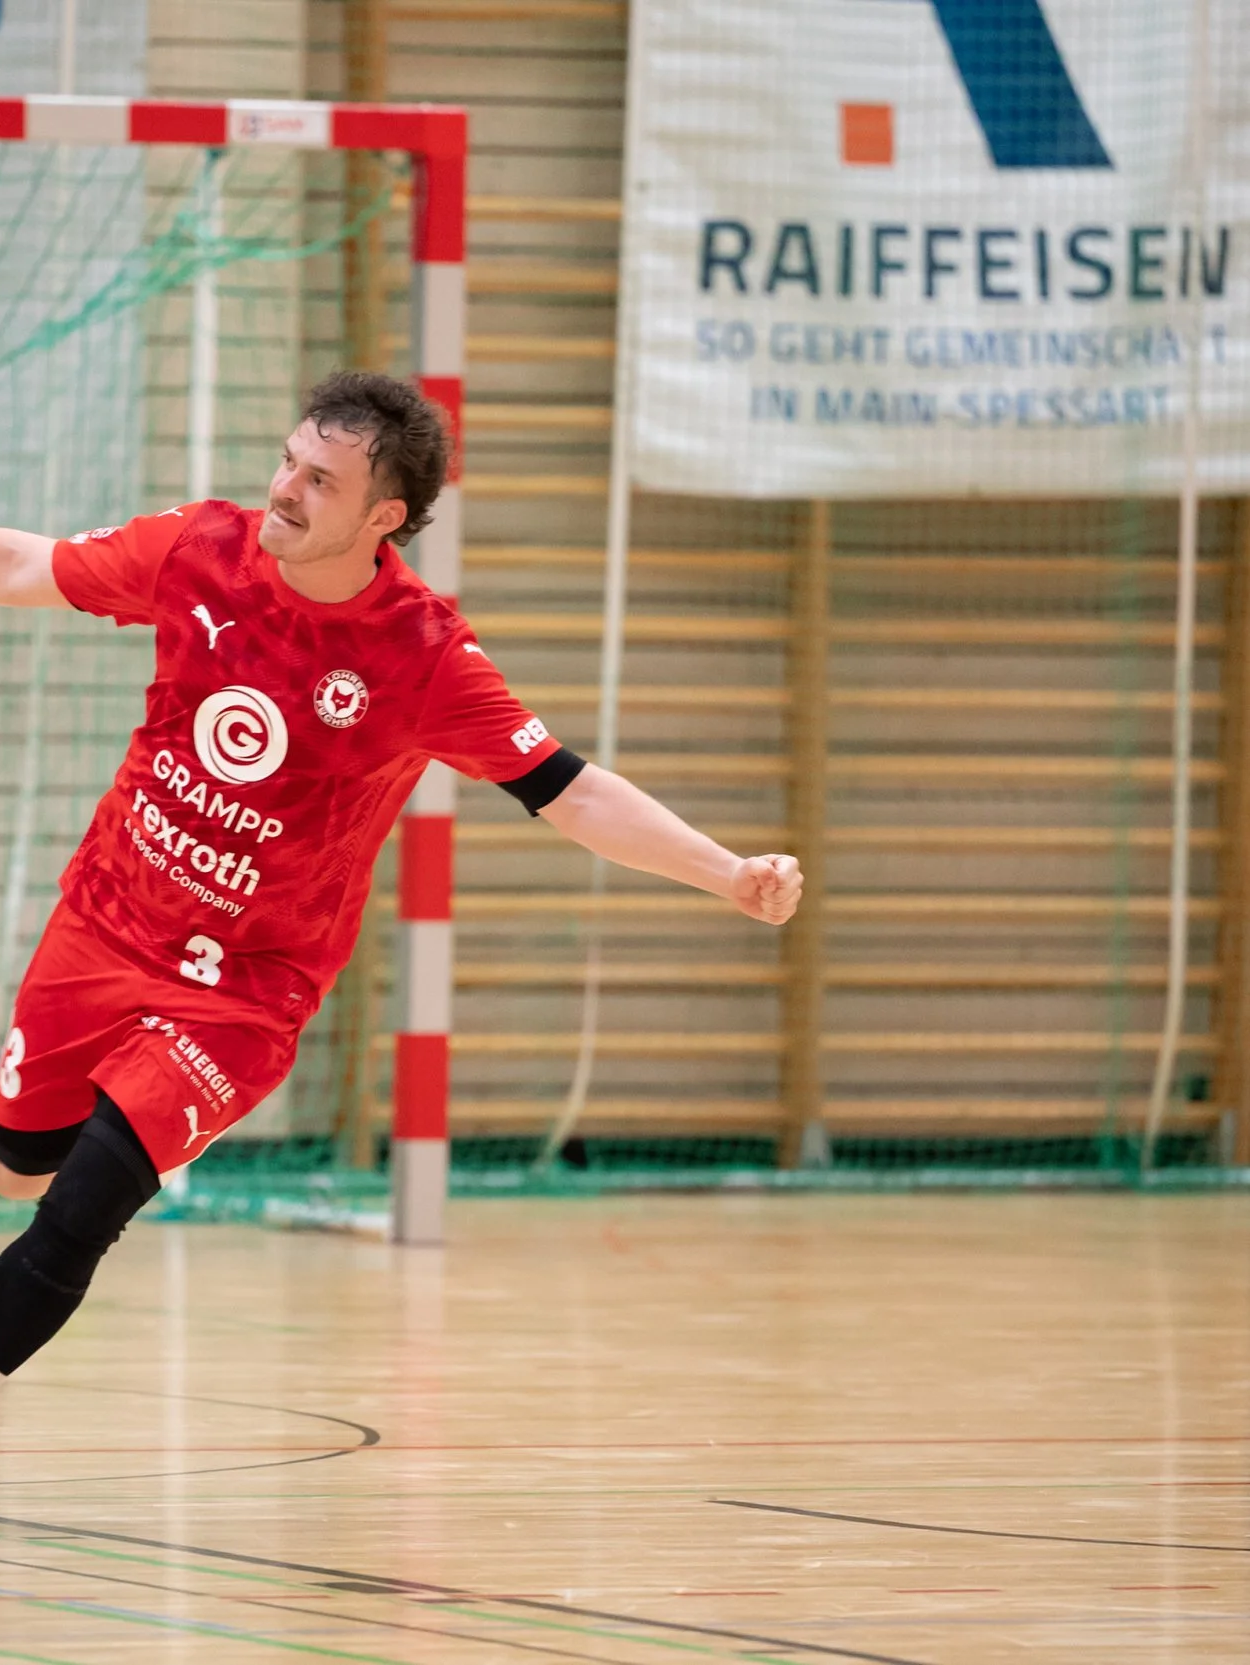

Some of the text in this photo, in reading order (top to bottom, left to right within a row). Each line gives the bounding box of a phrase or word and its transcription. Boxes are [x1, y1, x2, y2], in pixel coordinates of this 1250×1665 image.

[697, 221, 1229, 301] RAIFFEISEN
[696, 320, 1226, 369] SO GEHT GEMEINSCHAT
[750, 385, 799, 423] IN
[326, 671, 367, 698] LOHRER
[152, 749, 284, 843] GRAMPP
[131, 788, 261, 896] rexroth
[132, 828, 167, 871] Bosch
[169, 865, 245, 917] Company
[179, 934, 224, 987] 3
[0, 1027, 26, 1099] 3
[175, 1033, 236, 1104] ENERGIE
